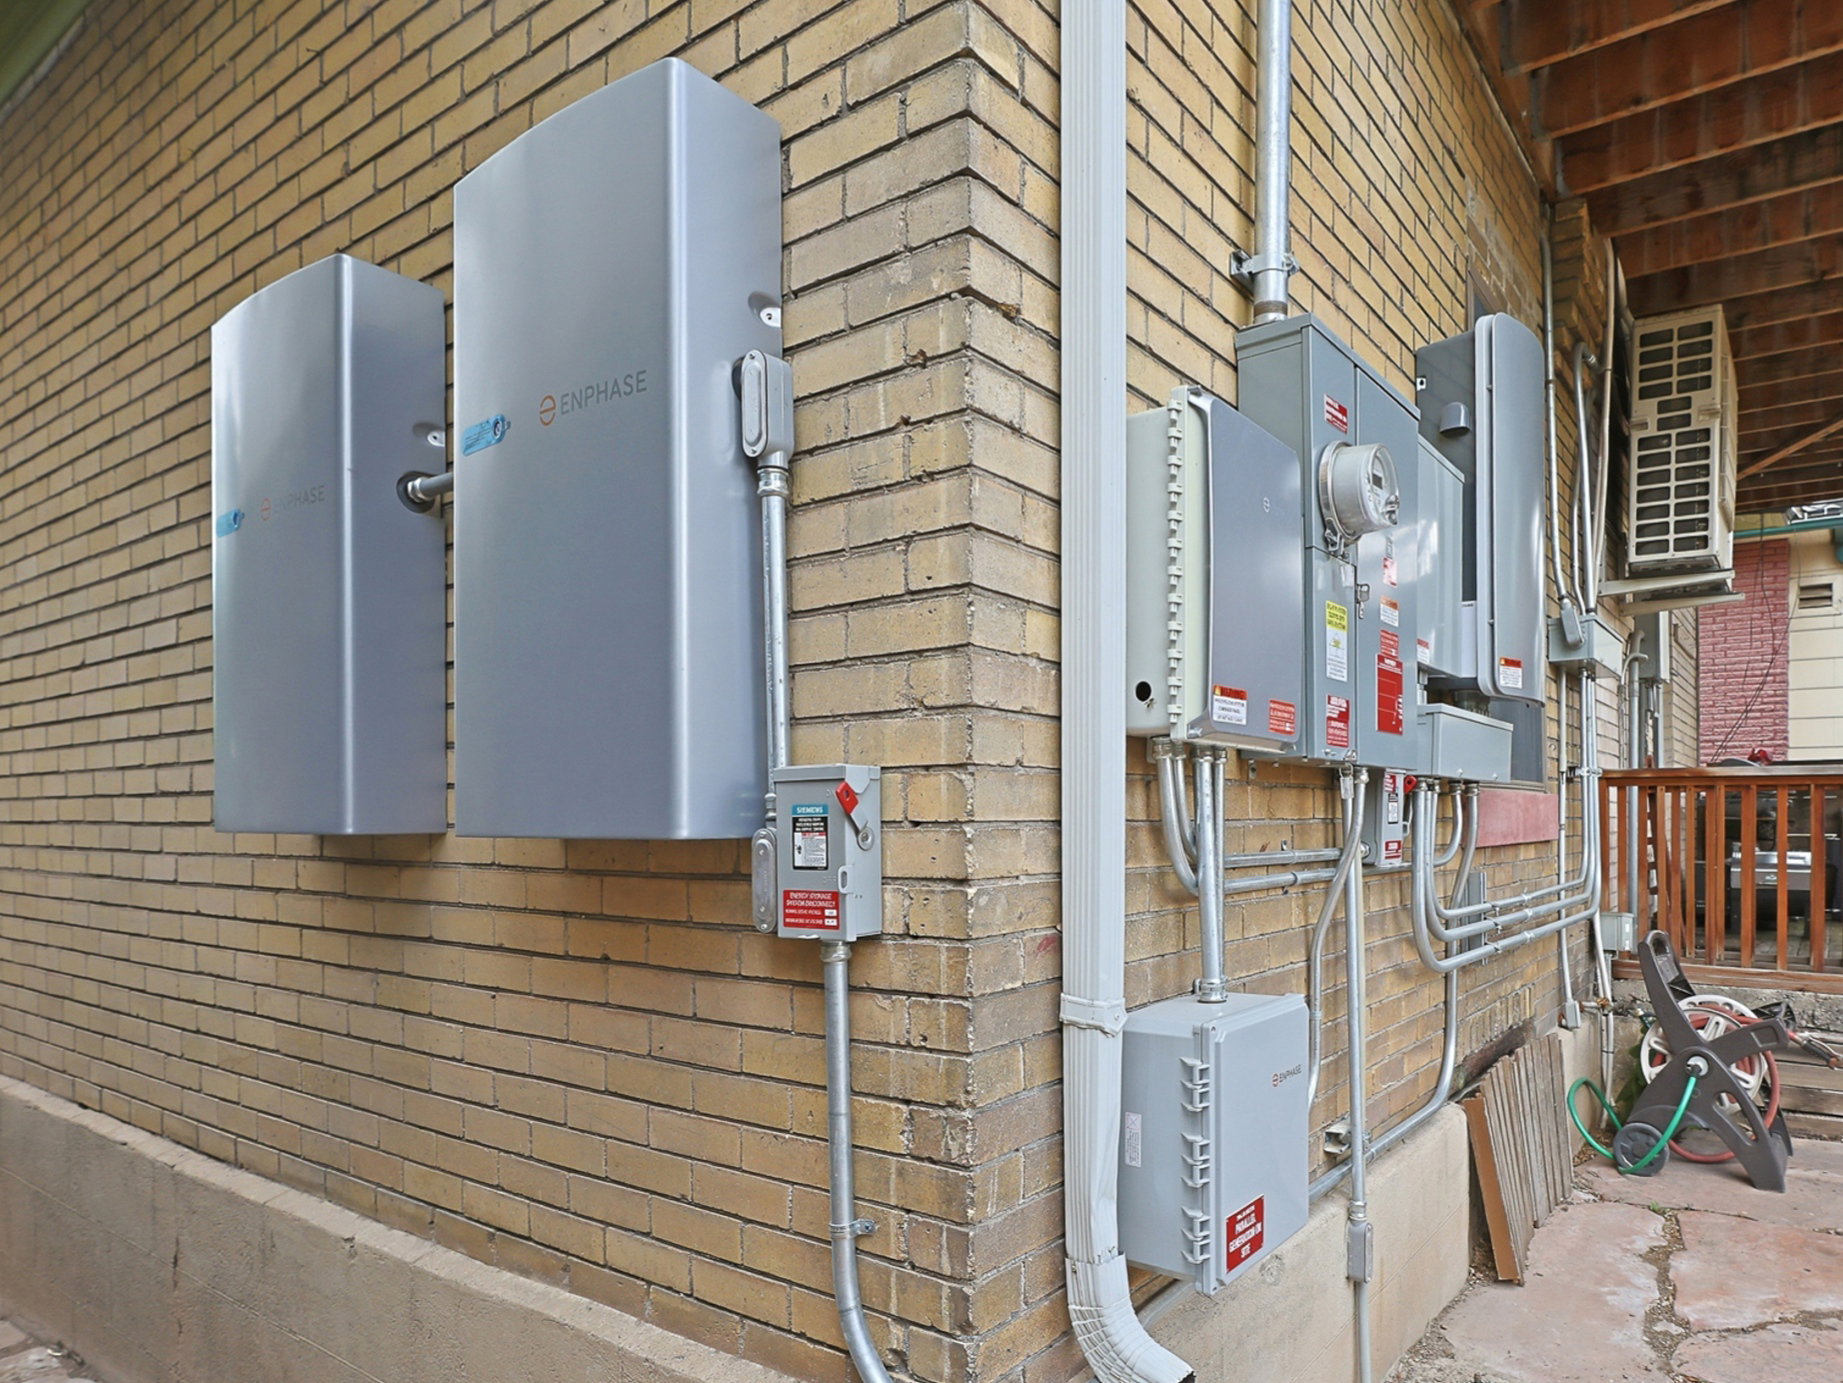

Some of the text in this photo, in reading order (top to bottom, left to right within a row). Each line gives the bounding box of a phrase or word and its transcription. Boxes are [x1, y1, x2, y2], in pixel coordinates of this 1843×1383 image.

[560, 369, 647, 416] ENPHASE
[796, 806, 823, 814] SIEMENS
[1279, 1064, 1302, 1083] ENPHASE
